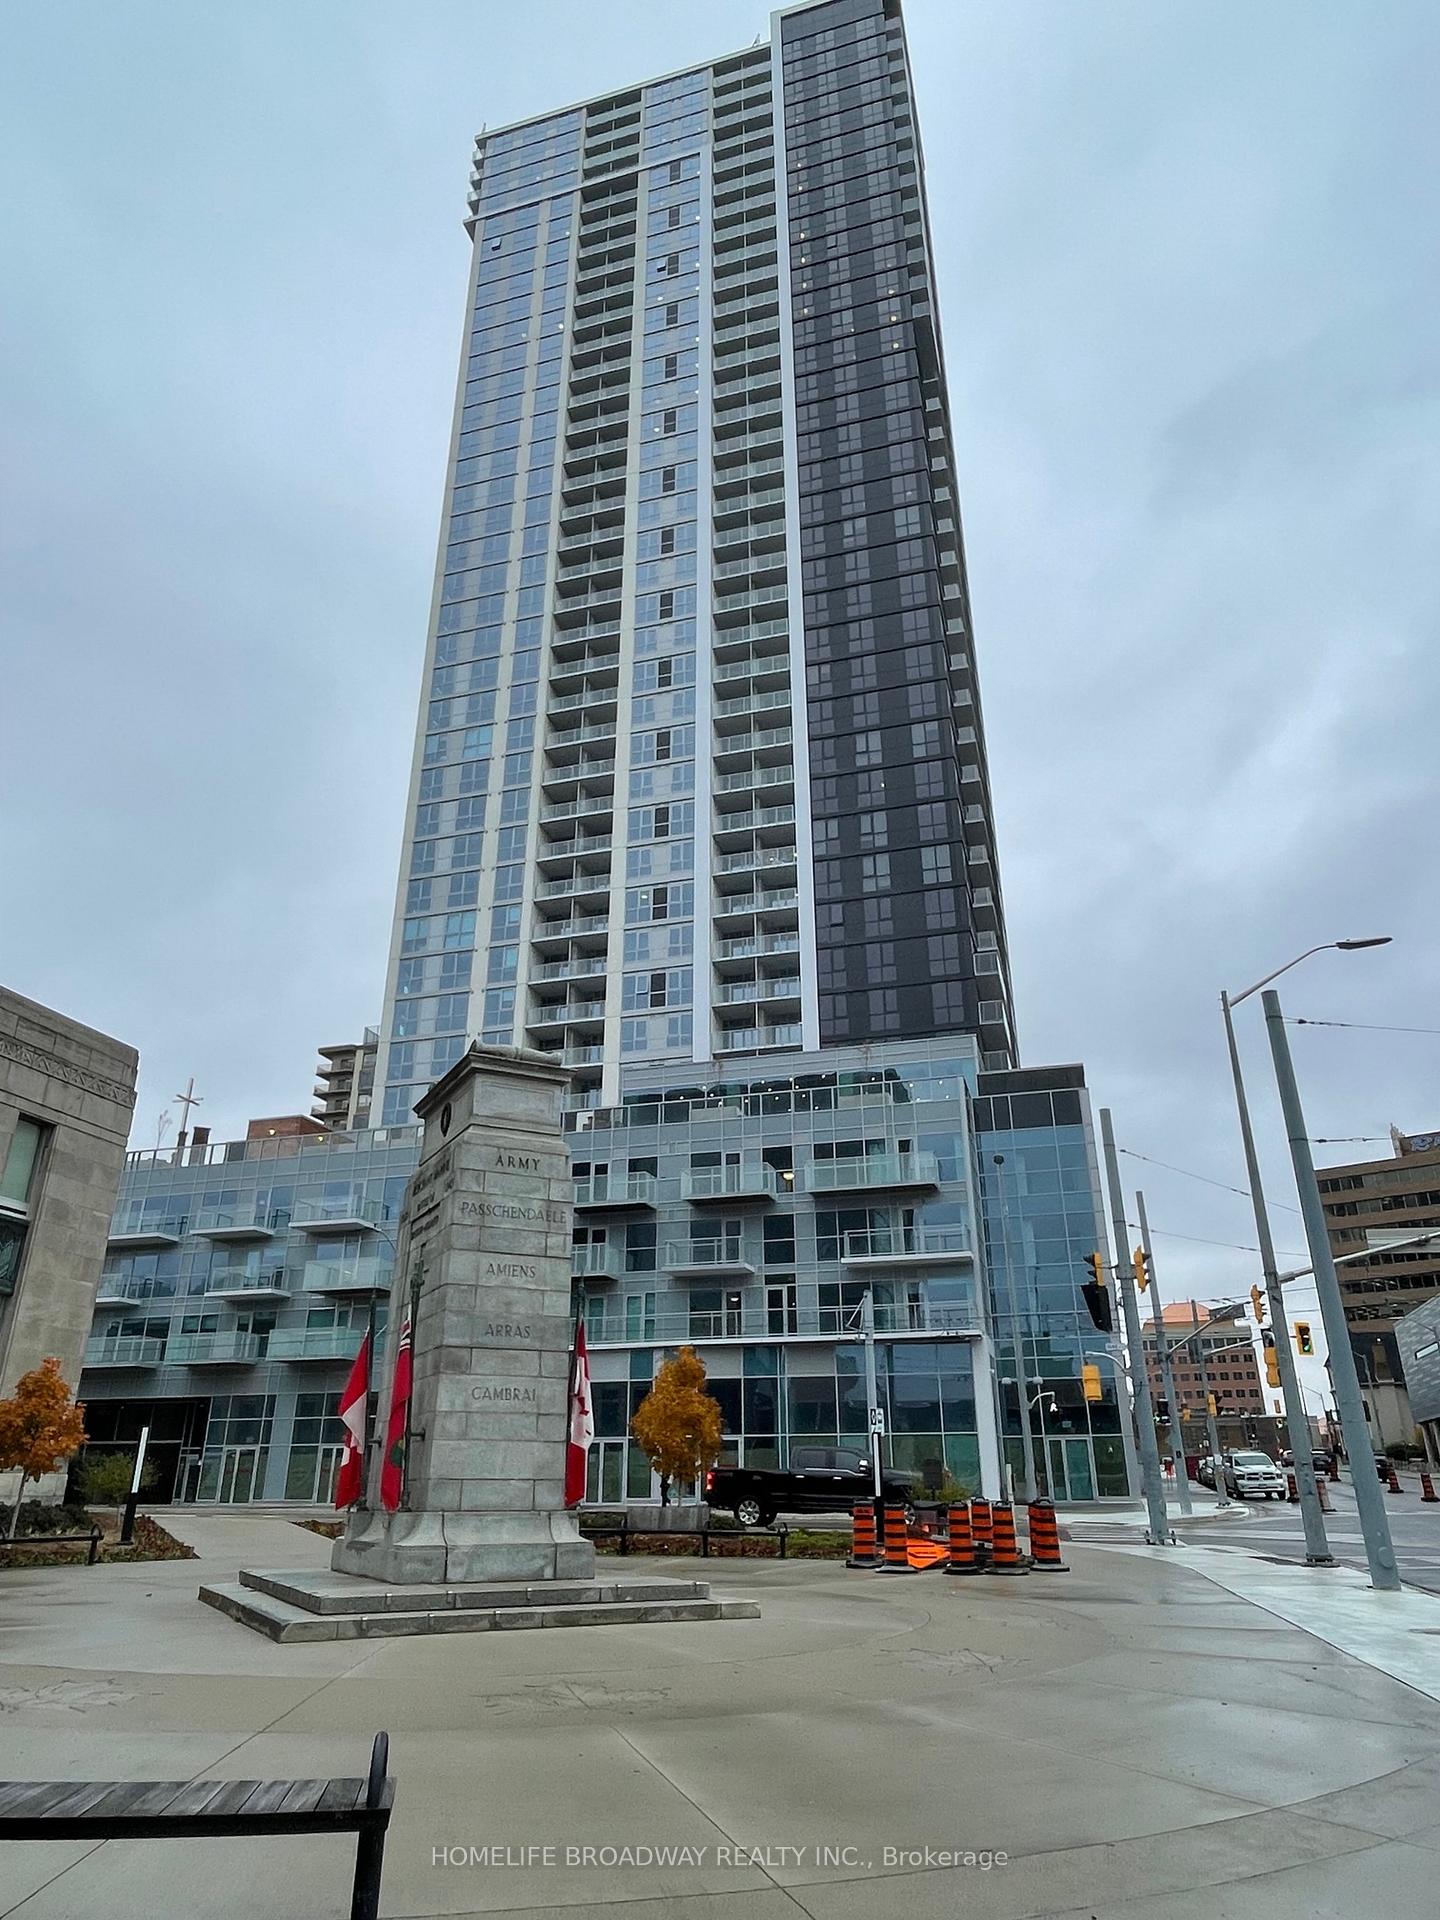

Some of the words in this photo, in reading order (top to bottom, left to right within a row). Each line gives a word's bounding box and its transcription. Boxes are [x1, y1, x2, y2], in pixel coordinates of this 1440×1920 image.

[496, 1154, 541, 1171] ARMY
[460, 1201, 567, 1224] PASSCHENDAELE
[486, 1262, 536, 1279] AMIENS
[484, 1323, 531, 1339] ARRAS
[471, 1386, 536, 1402] CAMBRAI
